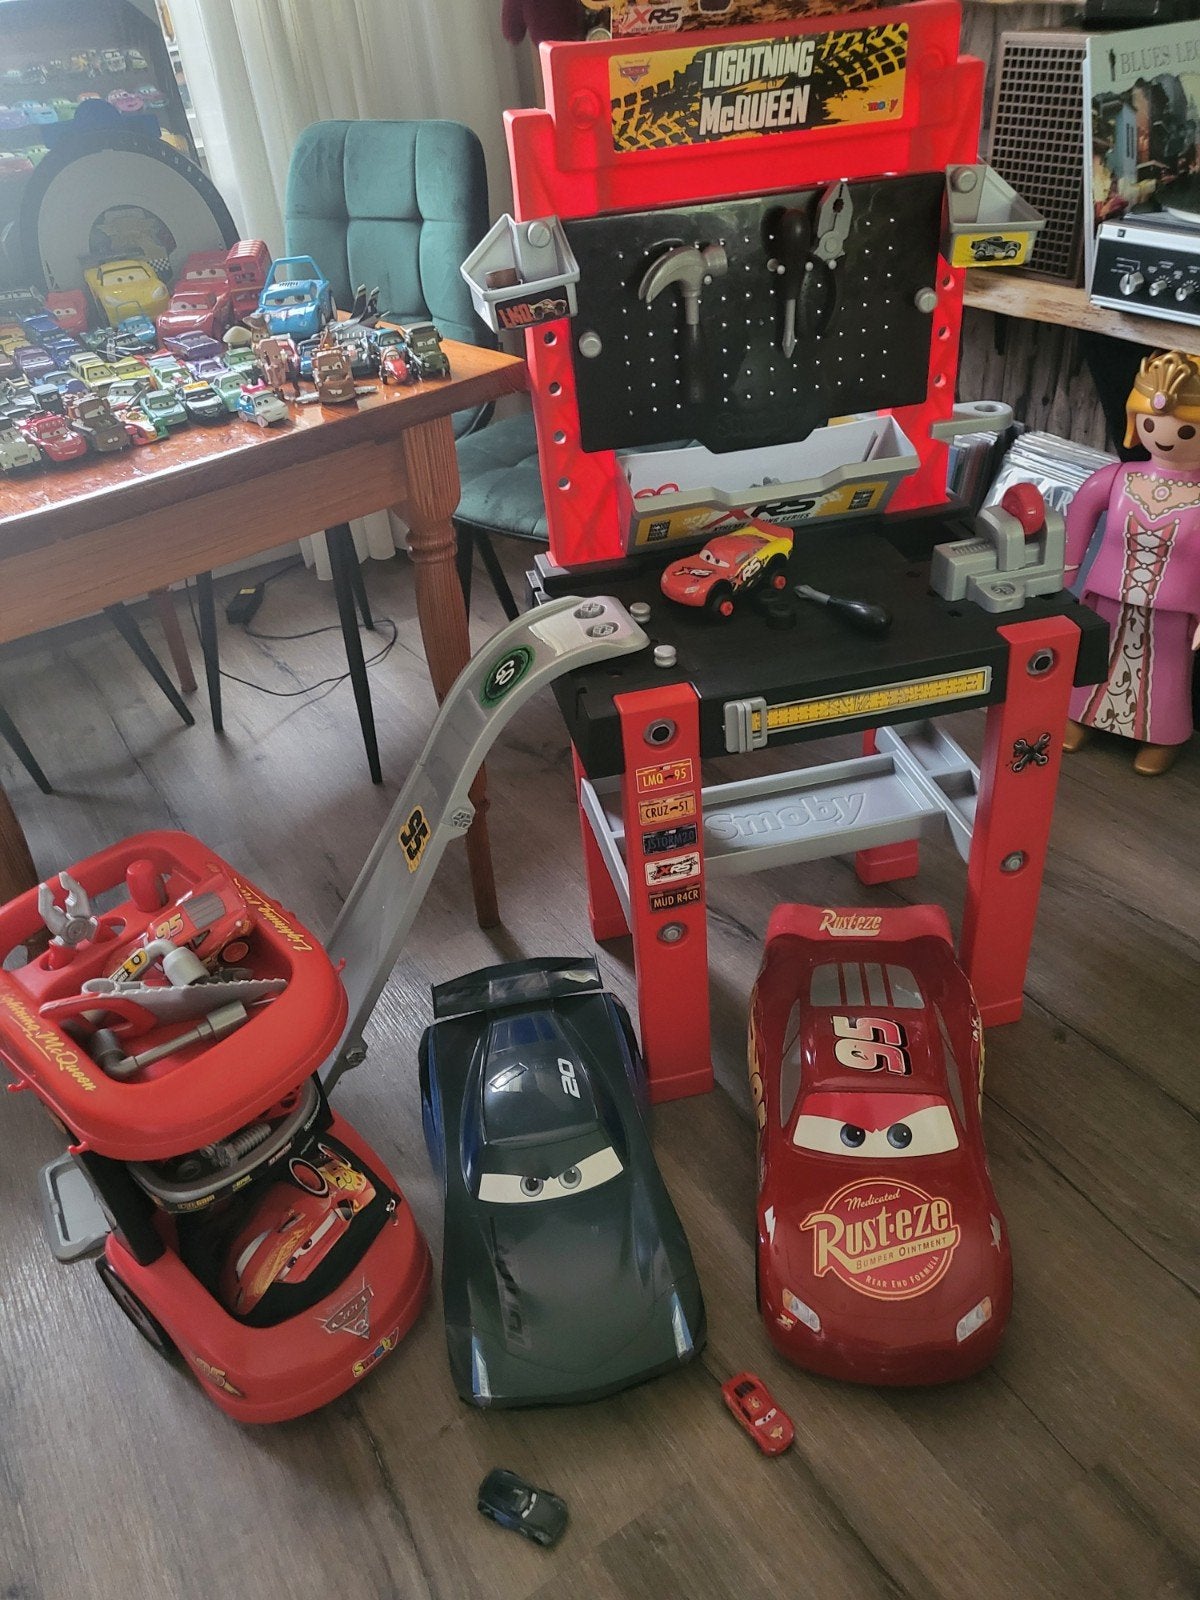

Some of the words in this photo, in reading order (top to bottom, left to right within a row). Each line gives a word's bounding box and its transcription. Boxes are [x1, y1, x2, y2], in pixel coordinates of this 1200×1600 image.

[622, 7, 682, 32] XRS
[702, 40, 815, 89] LIGHTNING
[1120, 45, 1170, 75] BLUES
[653, 895, 675, 909] MUD
[676, 889, 700, 904] R4CR
[156, 913, 185, 941] 95
[832, 1016, 913, 1076] 95
[557, 1057, 581, 1099] 20
[844, 1189, 901, 1212] Medicated
[899, 1236, 948, 1258] OINTMENT
[865, 1275, 888, 1288] REAR
[891, 1278, 908, 1288] END
[909, 1256, 940, 1285] FORMULA
